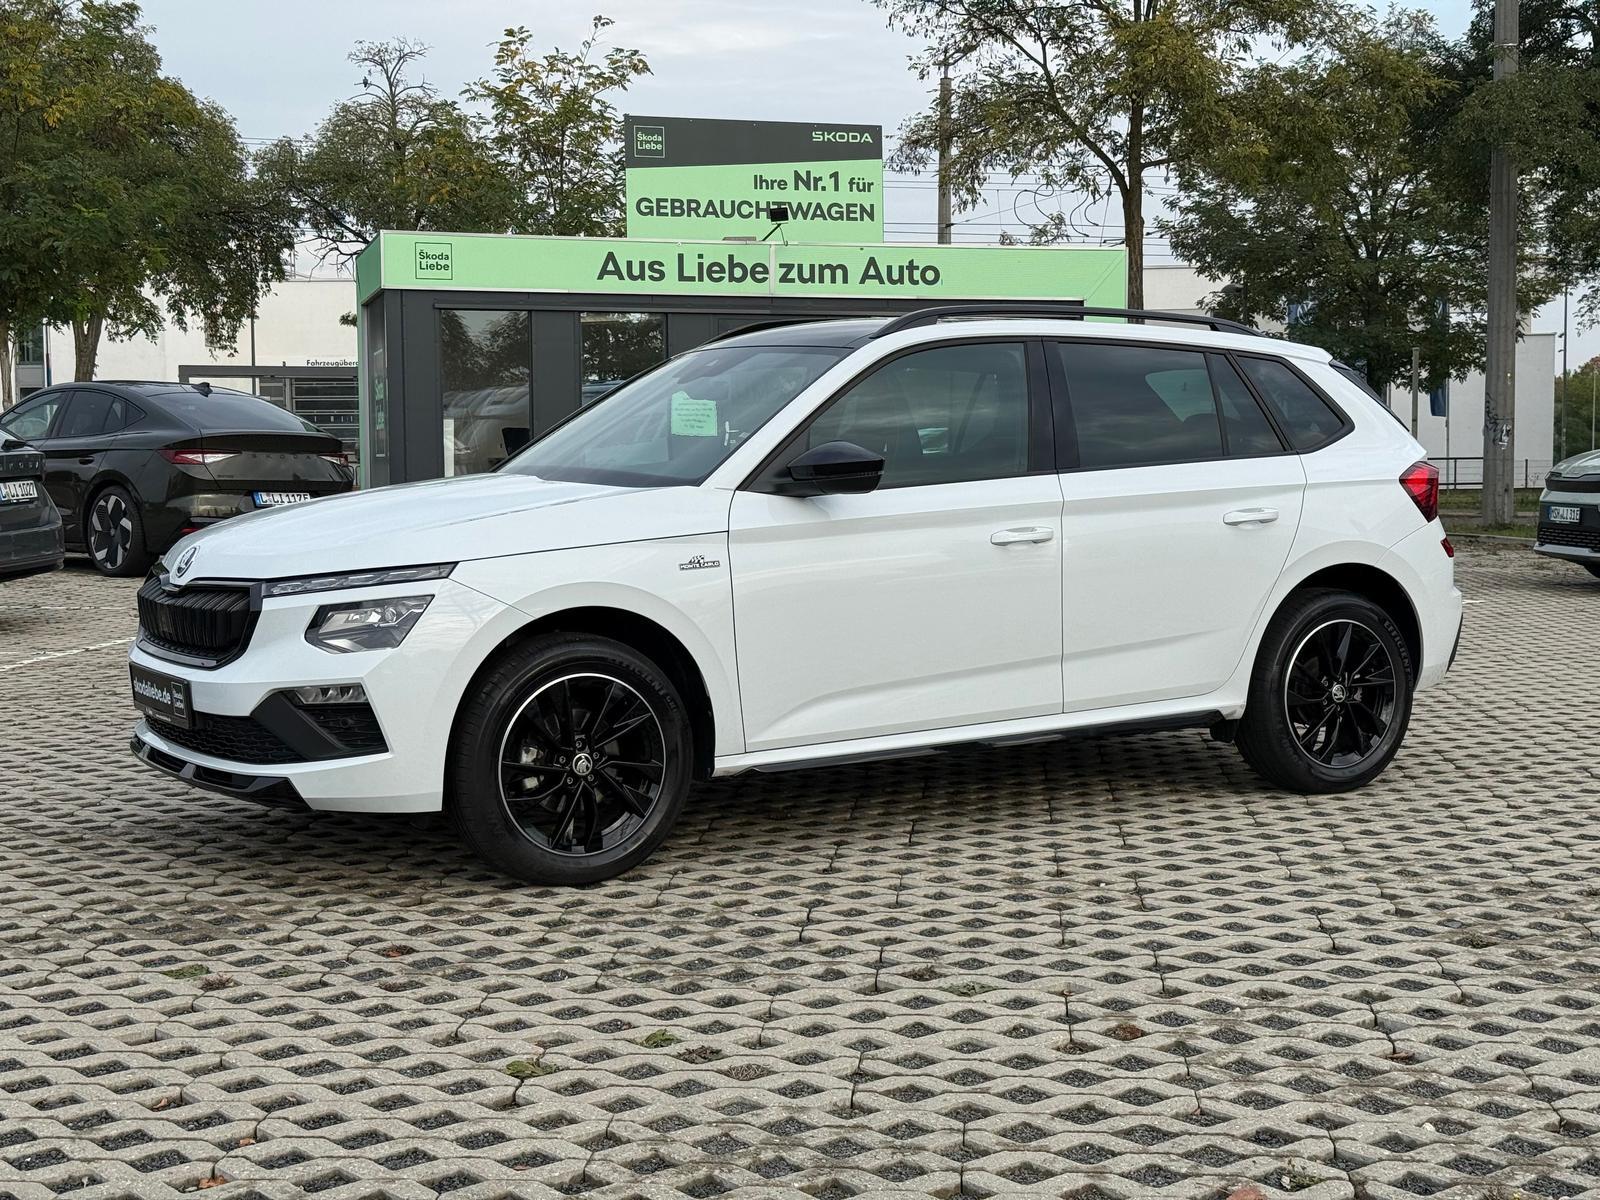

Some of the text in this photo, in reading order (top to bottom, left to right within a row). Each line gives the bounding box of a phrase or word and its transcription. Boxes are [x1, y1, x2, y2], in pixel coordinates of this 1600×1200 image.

[637, 131, 662, 141] Škoda
[637, 141, 663, 150] Liebe
[753, 170, 874, 193] Ihre Nr.1 für
[418, 249, 449, 260] Škoda
[419, 260, 450, 271] Liebe
[597, 251, 941, 286] Aus Liebe zum Auto
[701, 560, 720, 568] CARLO
